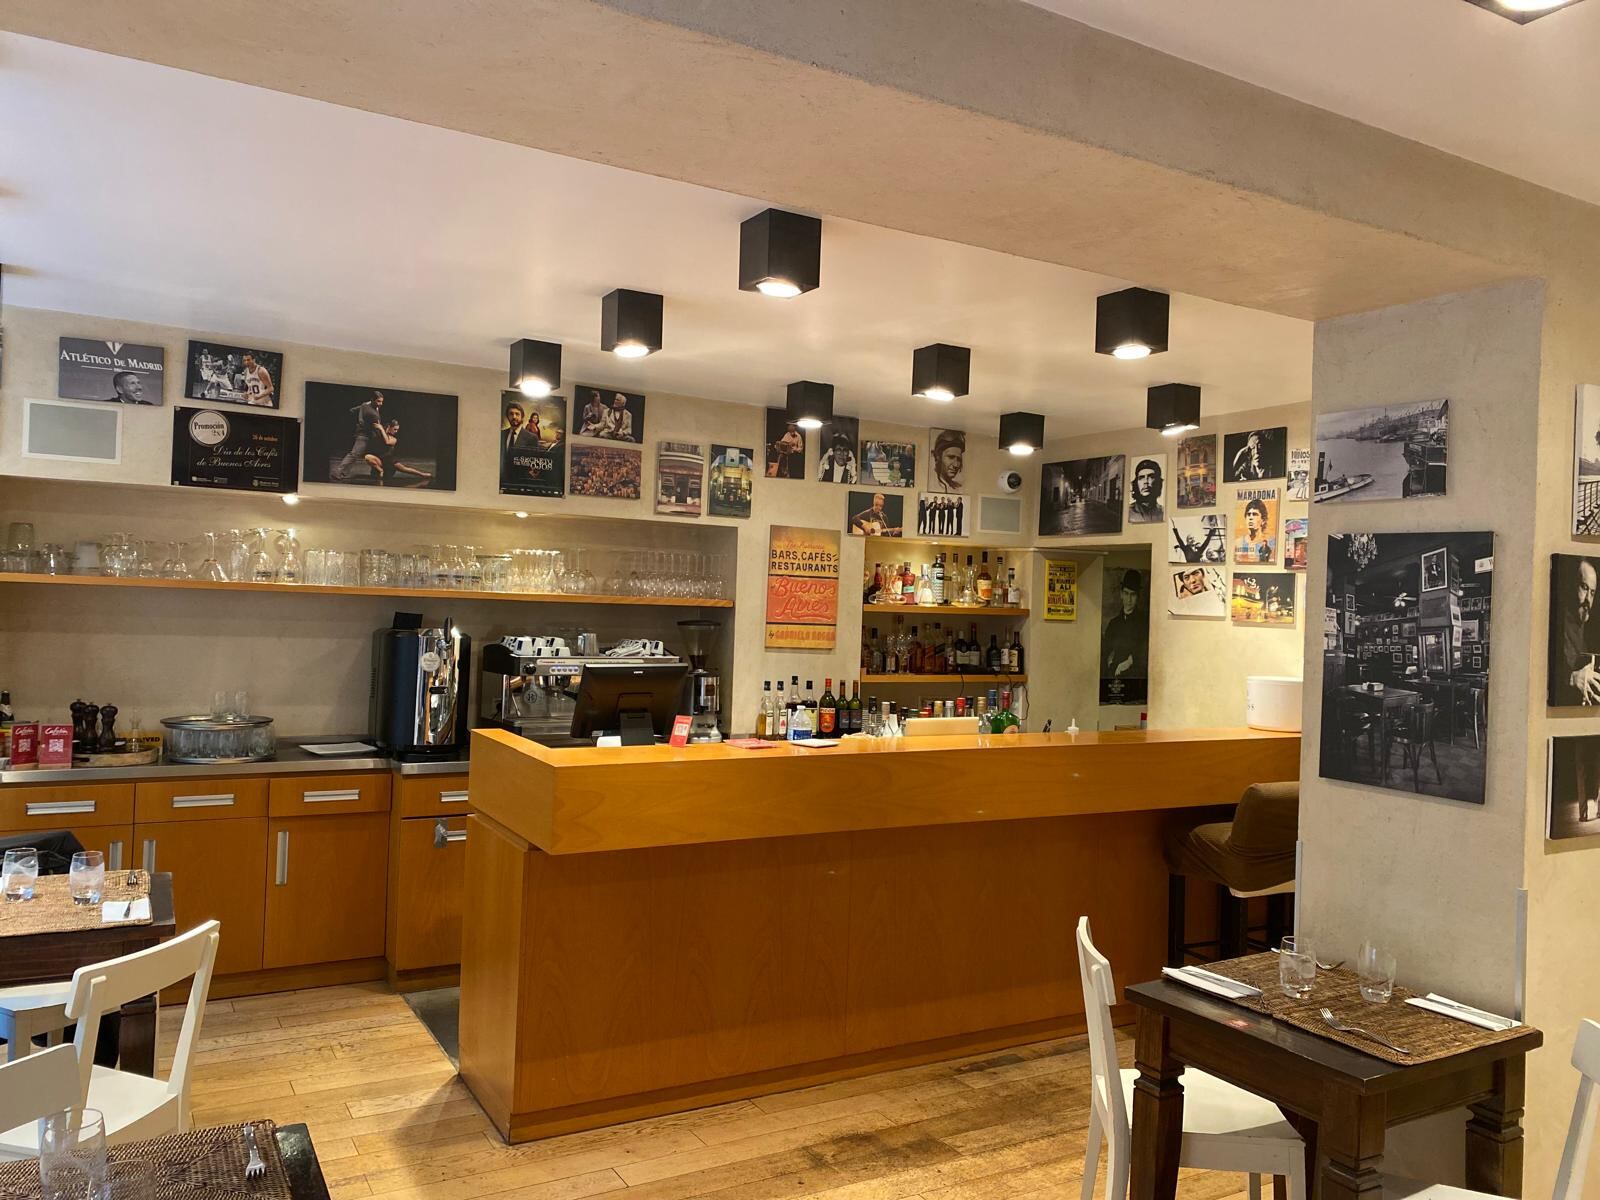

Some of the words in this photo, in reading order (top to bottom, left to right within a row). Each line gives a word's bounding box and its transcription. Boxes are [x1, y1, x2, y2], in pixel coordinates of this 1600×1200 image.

[60, 349, 111, 365] ATLÉTICO
[128, 358, 163, 371] MADRID
[194, 421, 225, 431] Promoción
[208, 458, 242, 468] Buenos
[1236, 489, 1276, 500] MARADONA
[801, 550, 832, 562] CAFÉS
[771, 561, 838, 573] RESTAURANTS
[774, 576, 837, 597] Buenos
[775, 596, 832, 620] Aires
